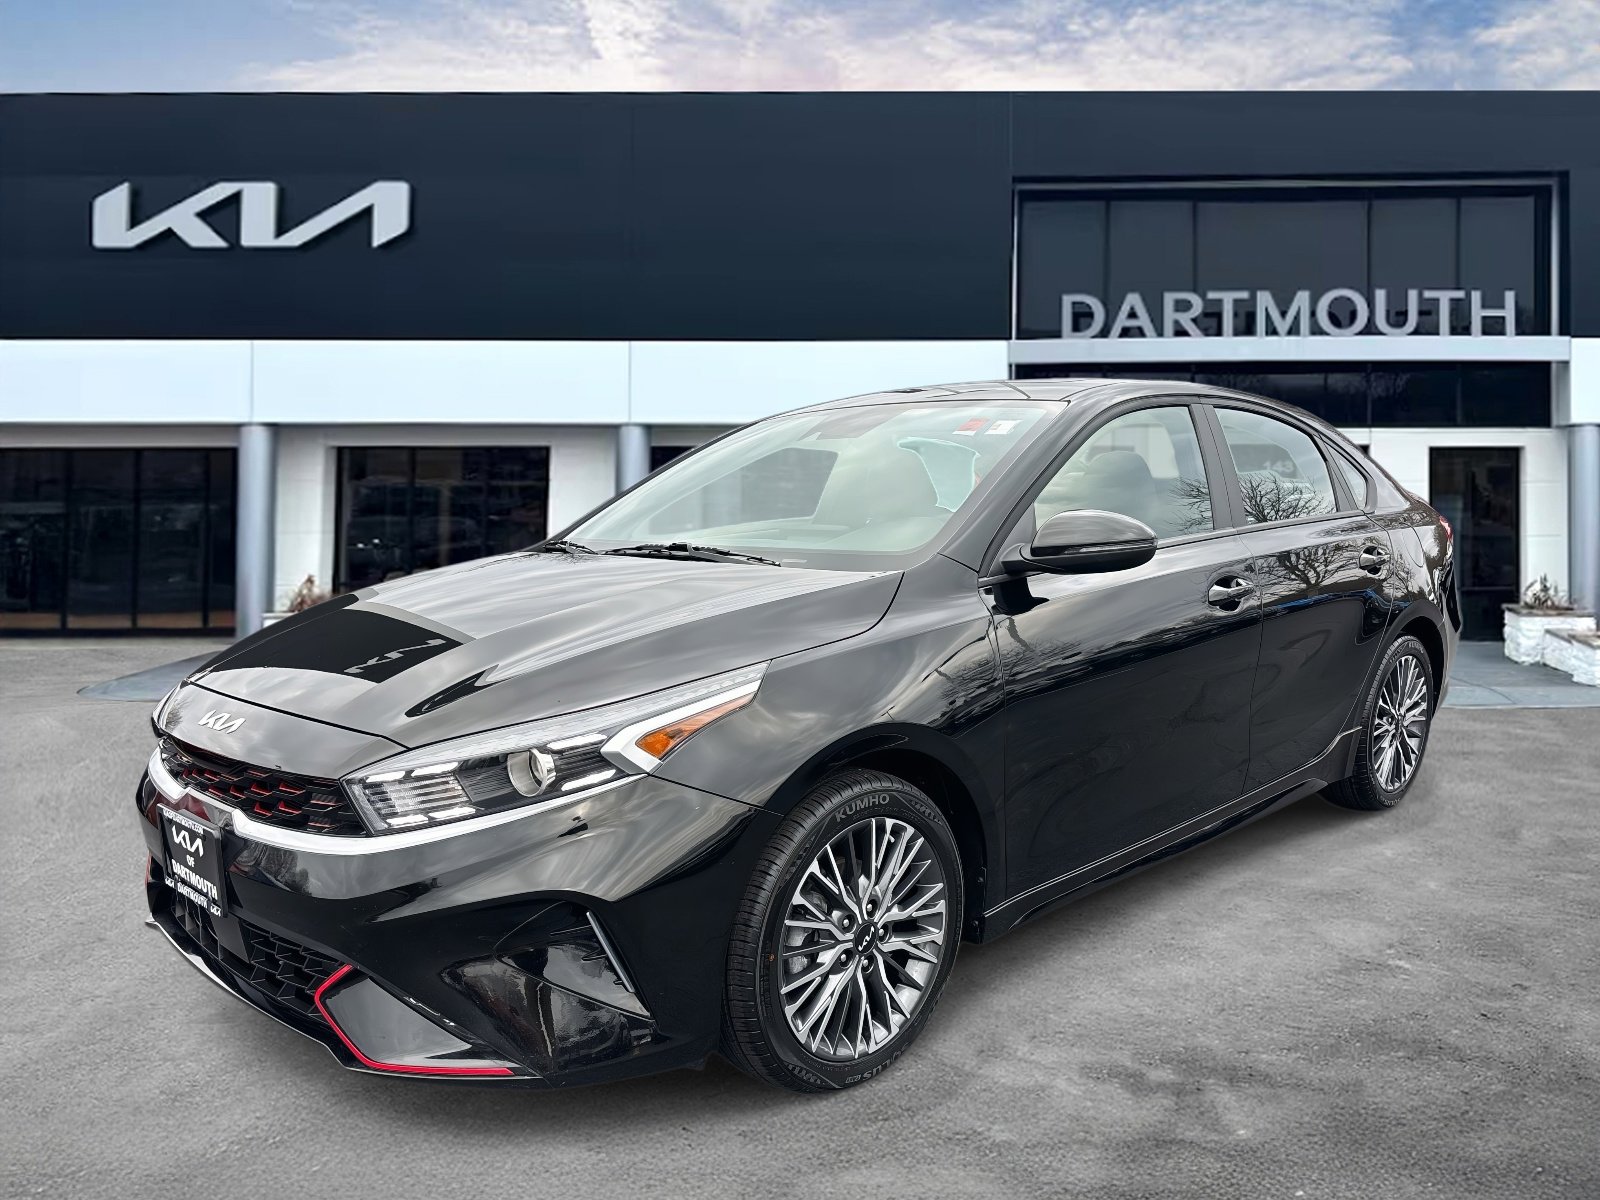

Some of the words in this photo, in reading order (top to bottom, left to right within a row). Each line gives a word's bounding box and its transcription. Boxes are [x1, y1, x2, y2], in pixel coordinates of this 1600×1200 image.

[92, 180, 411, 248] KIA
[1061, 288, 1517, 339] DARTMOUTH
[197, 709, 246, 734] KIA
[835, 793, 890, 822] KUMHO
[172, 824, 204, 857] KIA
[186, 854, 195, 868] OF
[172, 859, 218, 900] DARTMOUTH
